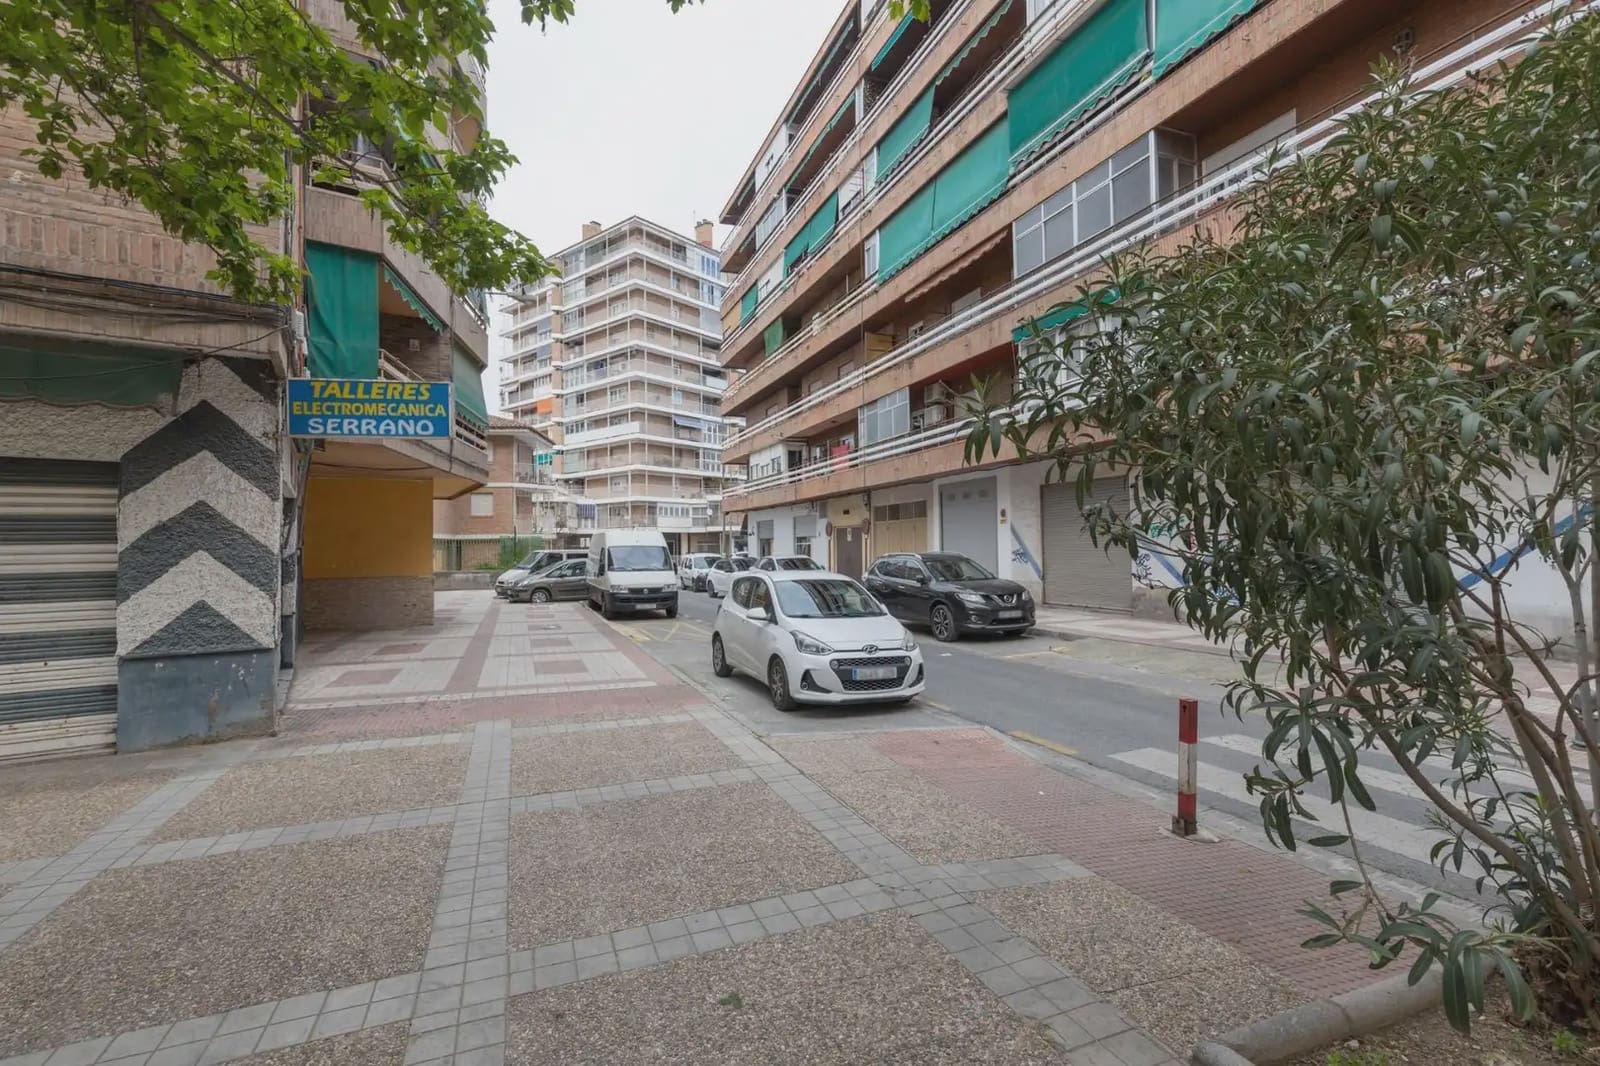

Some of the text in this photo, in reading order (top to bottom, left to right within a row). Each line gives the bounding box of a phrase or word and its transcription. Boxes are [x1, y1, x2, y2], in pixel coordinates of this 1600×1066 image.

[310, 381, 431, 400] TALLERES
[292, 402, 447, 417] ELECTROMECANICA
[308, 418, 434, 435] SERRANO
